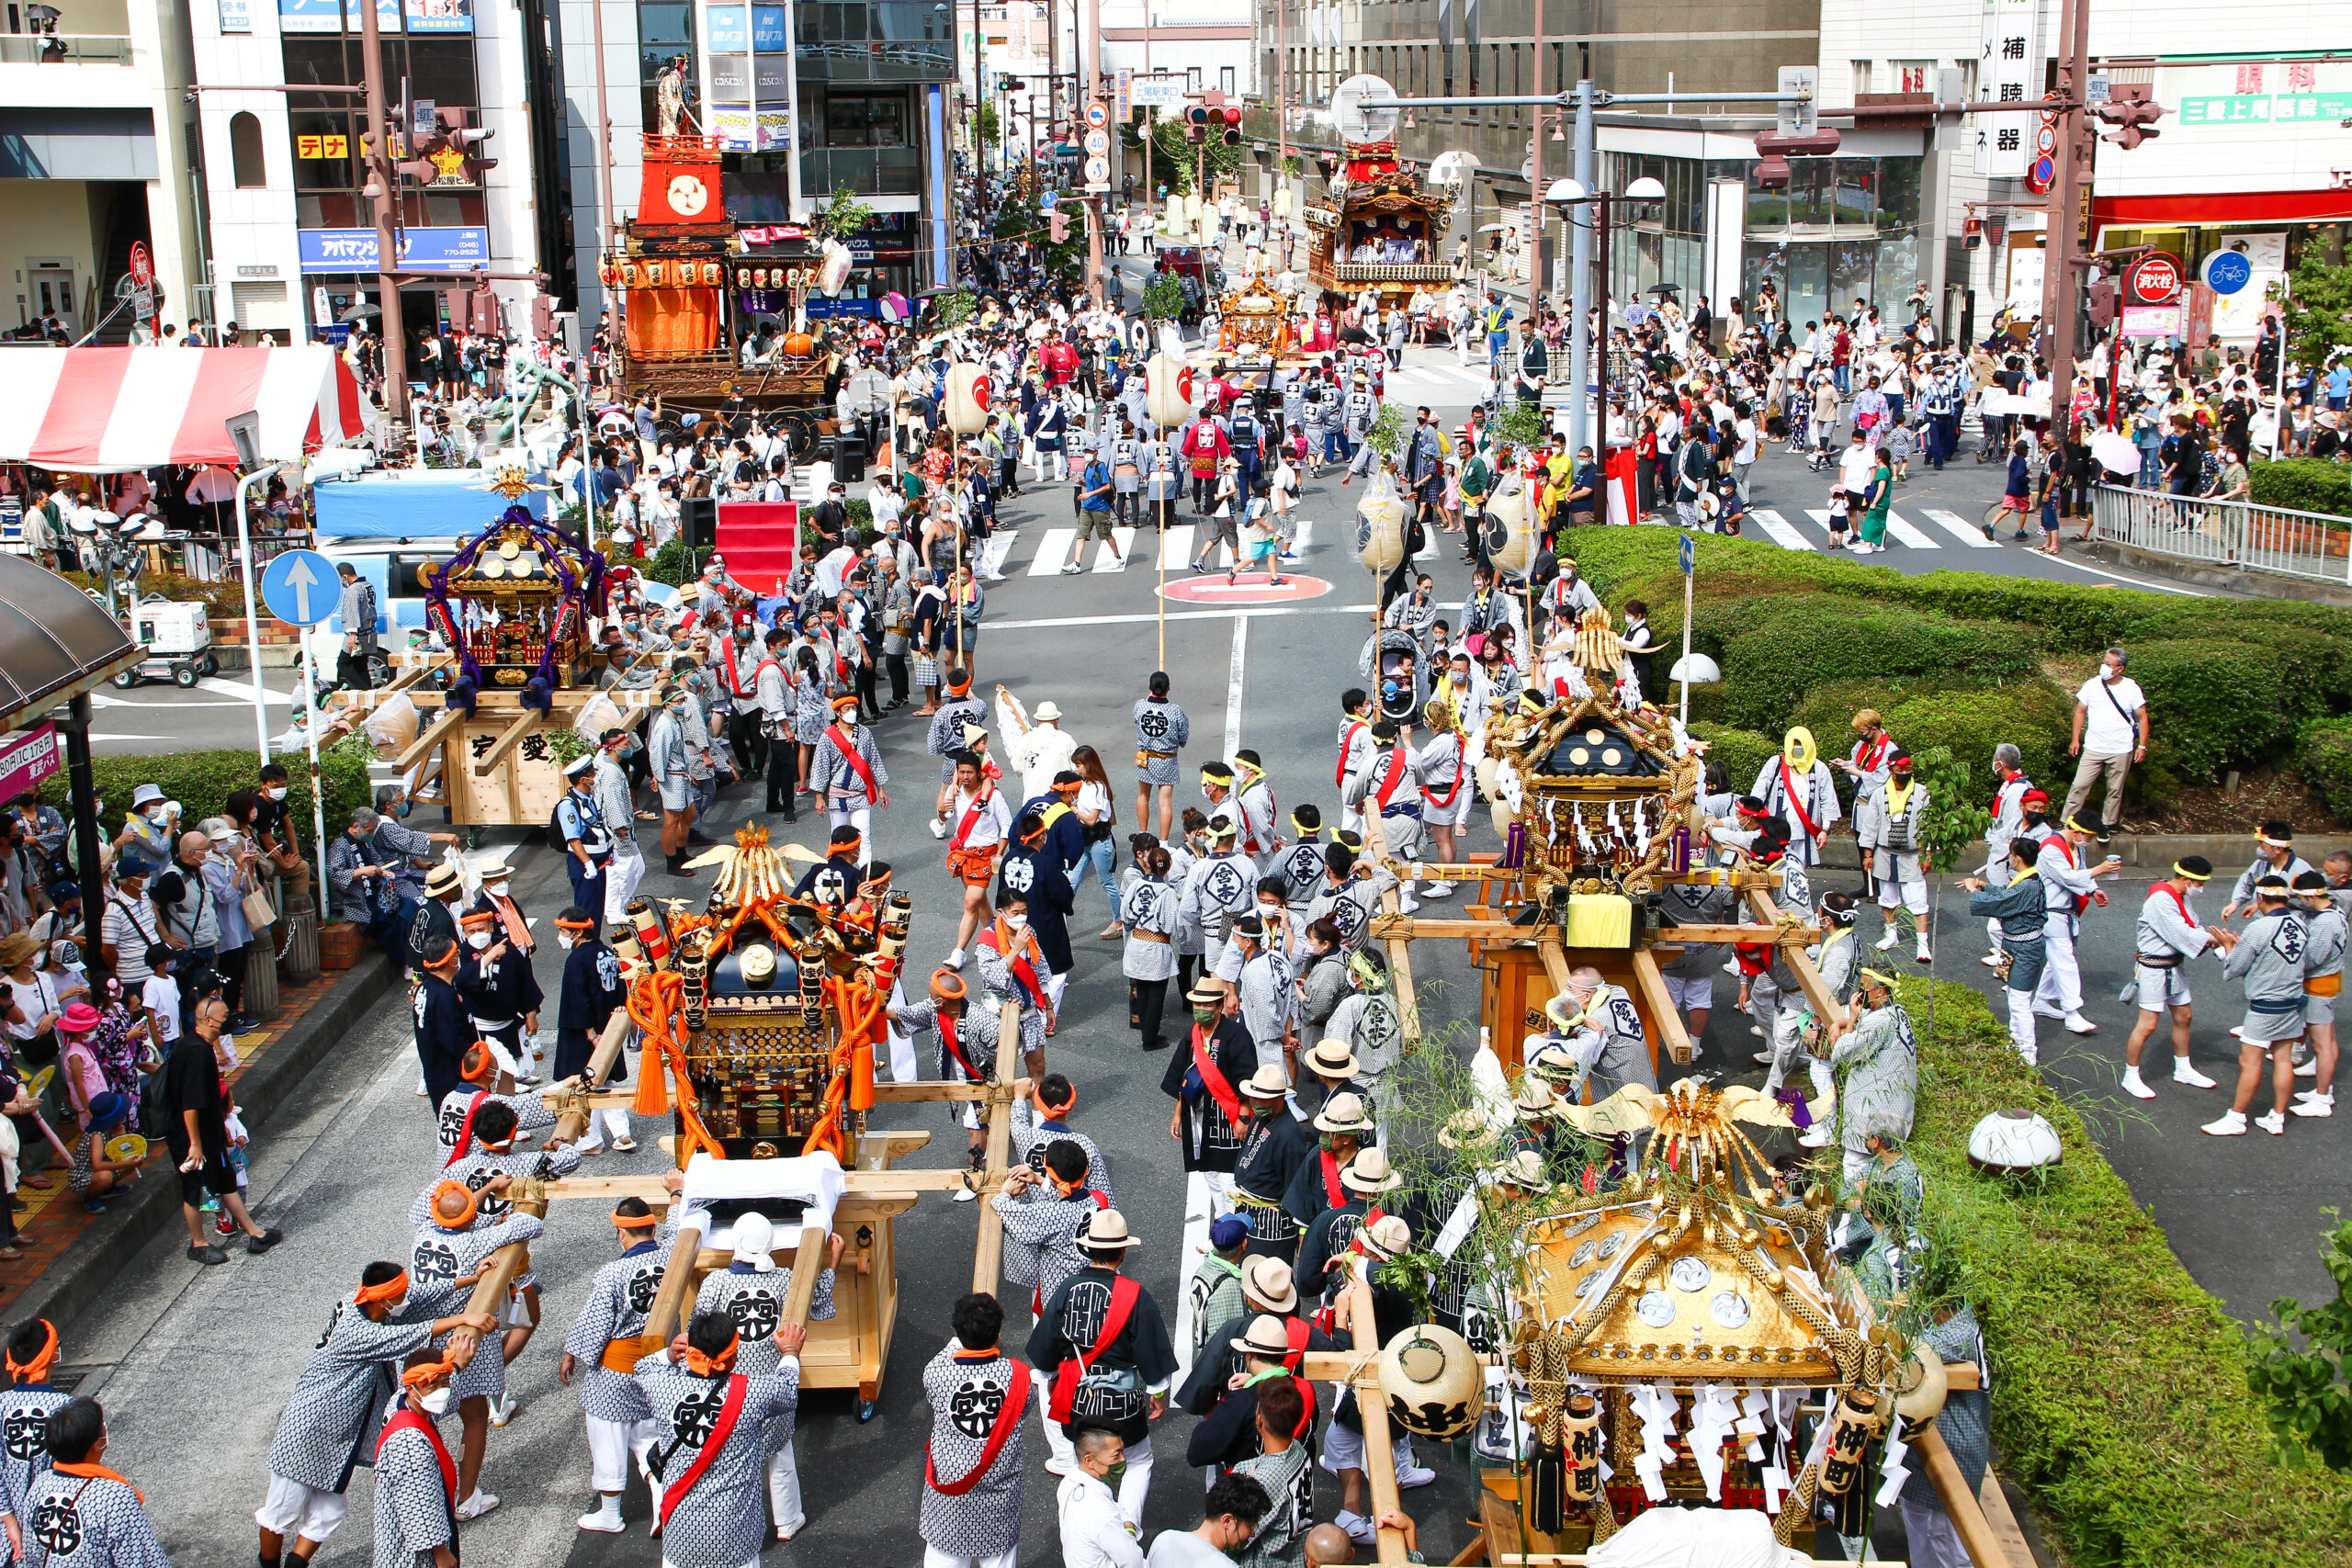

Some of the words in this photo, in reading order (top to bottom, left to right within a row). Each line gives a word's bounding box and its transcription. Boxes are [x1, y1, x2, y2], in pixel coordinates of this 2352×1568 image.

[1135, 86, 1179, 96] 上尾駅東口
[1997, 37, 2026, 151] 補聴器
[2235, 65, 2316, 94] 眼科
[1119, 72, 1128, 119] 歩車分離信号
[2184, 97, 2317, 121] 三愛上尾医院
[300, 139, 404, 156] テナト
[1091, 136, 1104, 148] 40
[2041, 133, 2052, 146] 40
[2138, 273, 2173, 289] 消火栓
[28, 753, 55, 780] 東武バス
[1295, 849, 1316, 884] 宮本
[1215, 865, 1236, 902] 宮本
[1334, 899, 1356, 933] 宮本
[2281, 919, 2302, 961] 宮本
[1571, 1426, 1600, 1494] 仲町
[1824, 1419, 1871, 1492] 仲町
